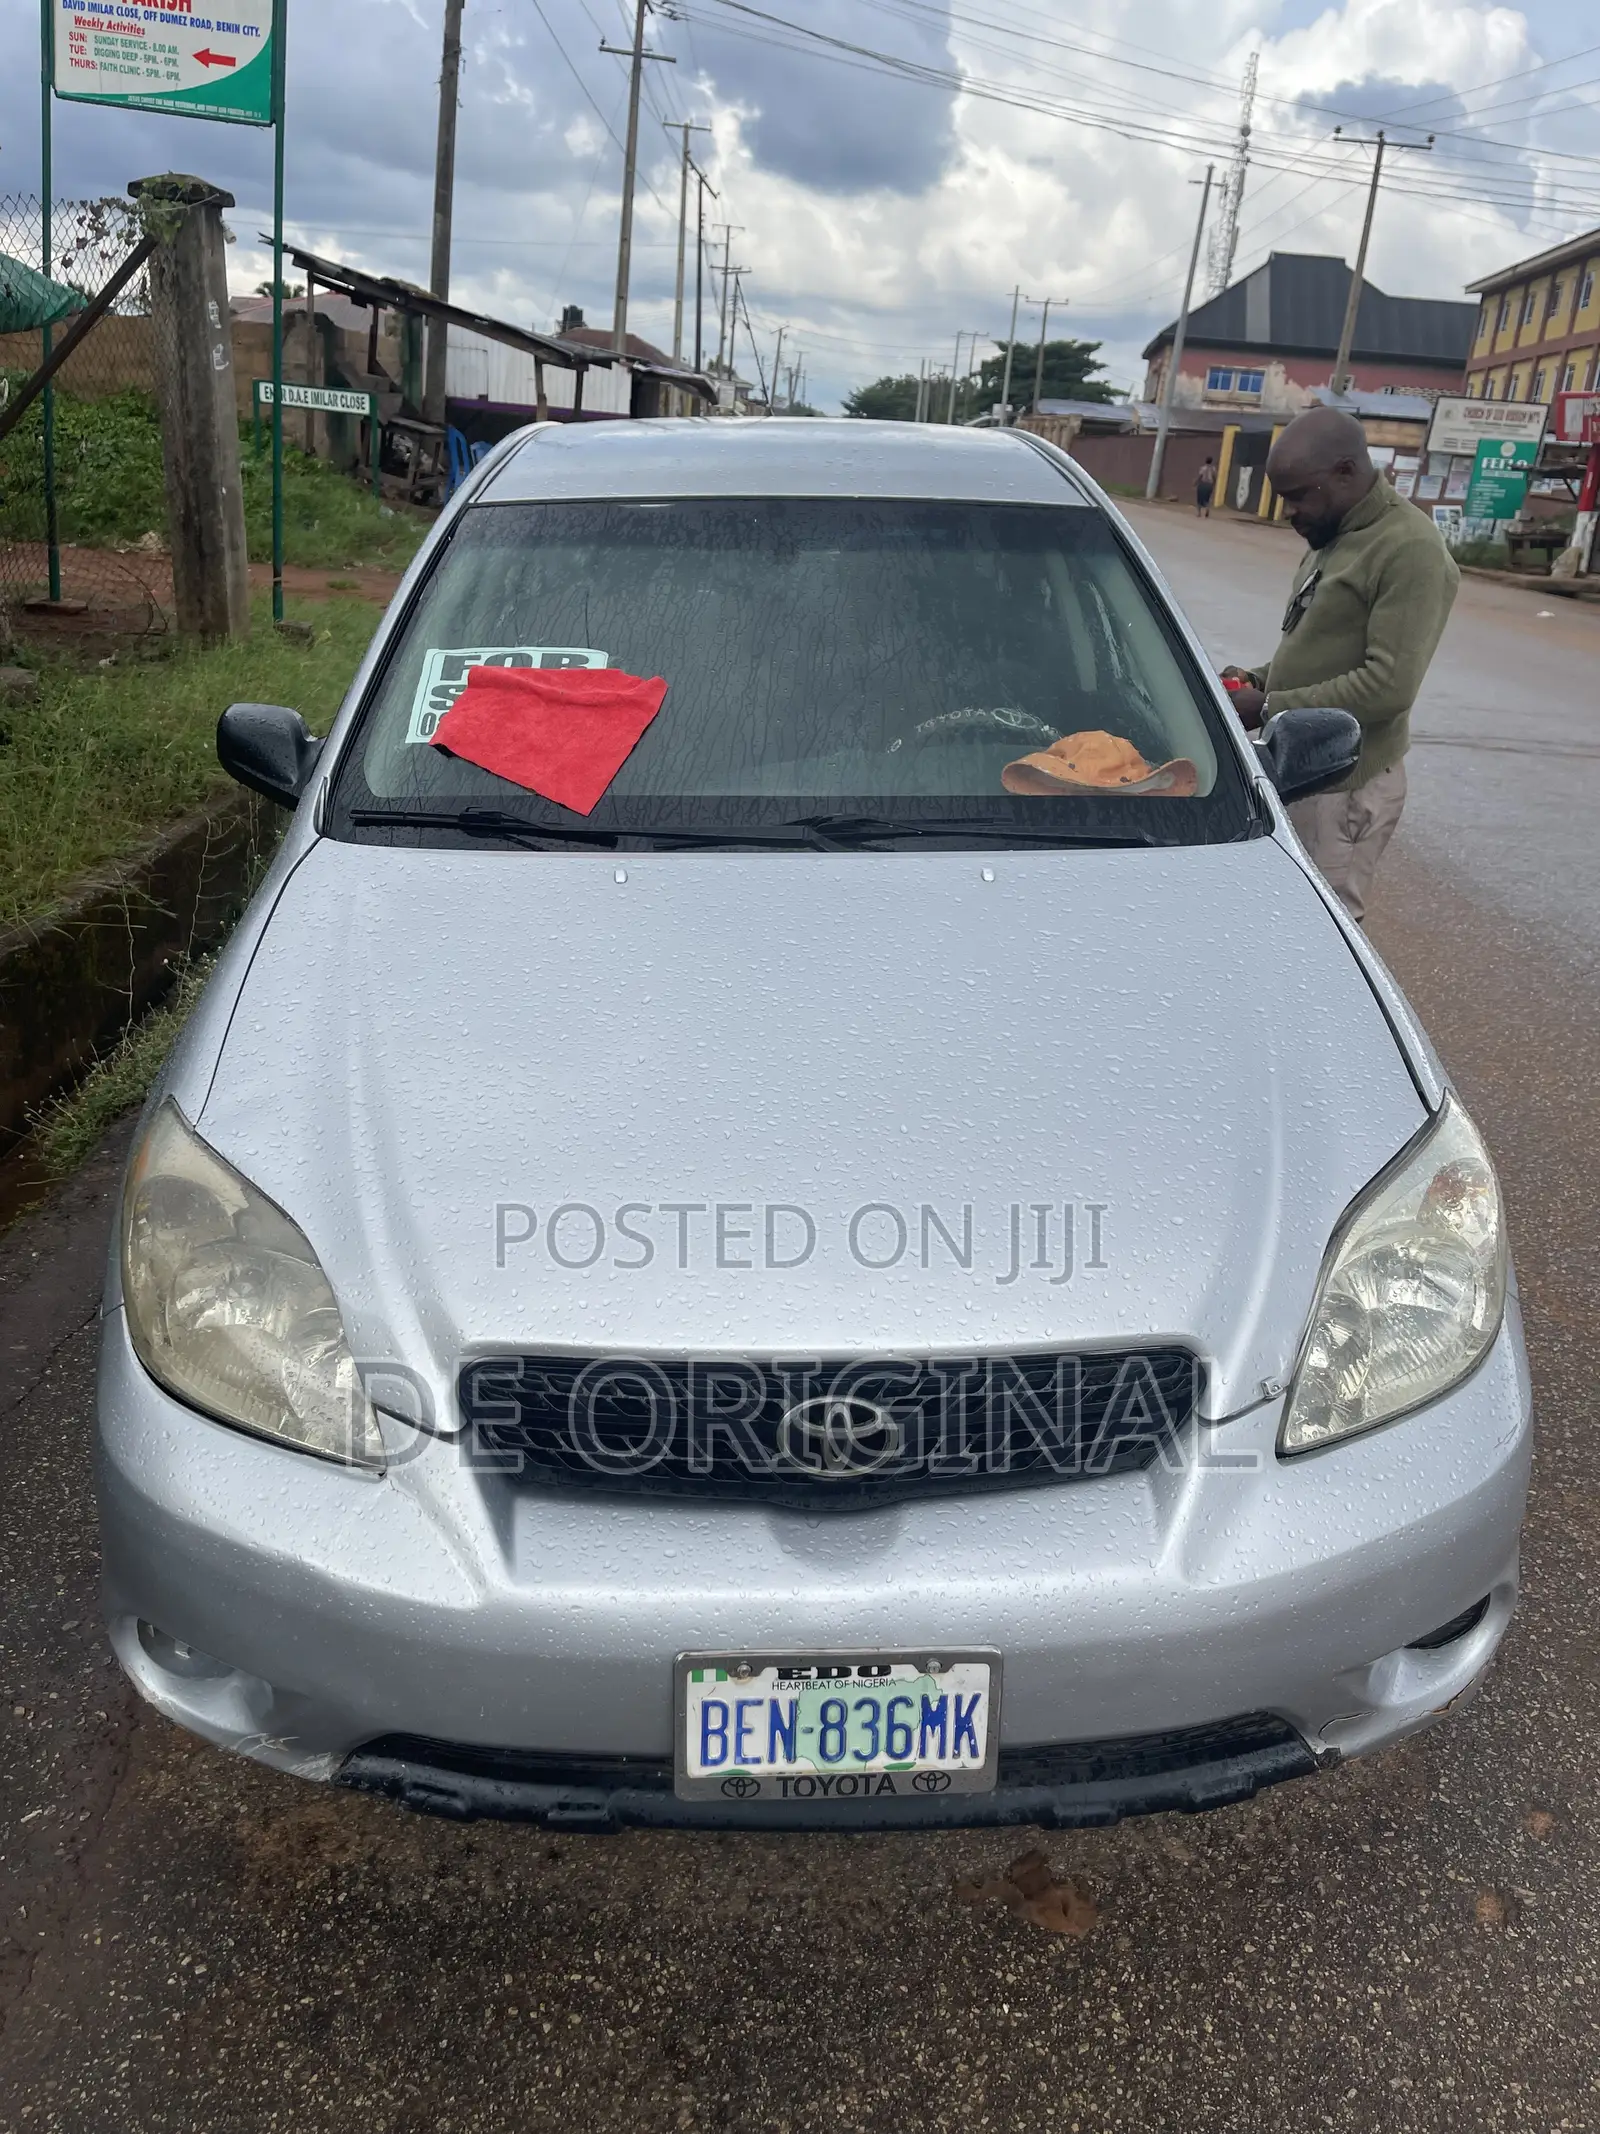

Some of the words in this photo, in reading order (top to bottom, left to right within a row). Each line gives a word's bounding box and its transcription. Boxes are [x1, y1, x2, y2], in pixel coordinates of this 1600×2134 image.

[62, 0, 86, 11] DAVID
[88, 2, 115, 16] IMILAR
[116, 6, 141, 21] CLOSE,
[143, 9, 158, 21] OFF
[159, 12, 188, 26] DUMEZ
[189, 17, 214, 32] ROAD,
[216, 21, 240, 34] BENIN
[242, 25, 261, 37] CITY.
[74, 15, 104, 30] Weekly
[106, 20, 146, 35] Activities
[69, 31, 88, 42] SUN:
[94, 34, 119, 46] SUNDAY
[120, 38, 148, 50] SERVICE
[69, 44, 87, 55] TUE:
[94, 47, 121, 59] DIGGING
[121, 51, 138, 62] DEEP
[69, 58, 98, 70] THURS:
[100, 62, 118, 72] FAITH
[119, 64, 141, 76] CLINIC
[310, 391, 338, 407] IMILAR
[340, 394, 366, 410] CLOSE
[914, 706, 986, 733] TOYOTA
[776, 1664, 892, 1680] EDO
[772, 1679, 832, 1691] HEARTBEAT
[834, 1680, 850, 1689] OF
[852, 1677, 897, 1688] NIGERIA
[700, 1692, 982, 1767] BEN-836MK
[776, 1773, 897, 1797] TOYOTA
